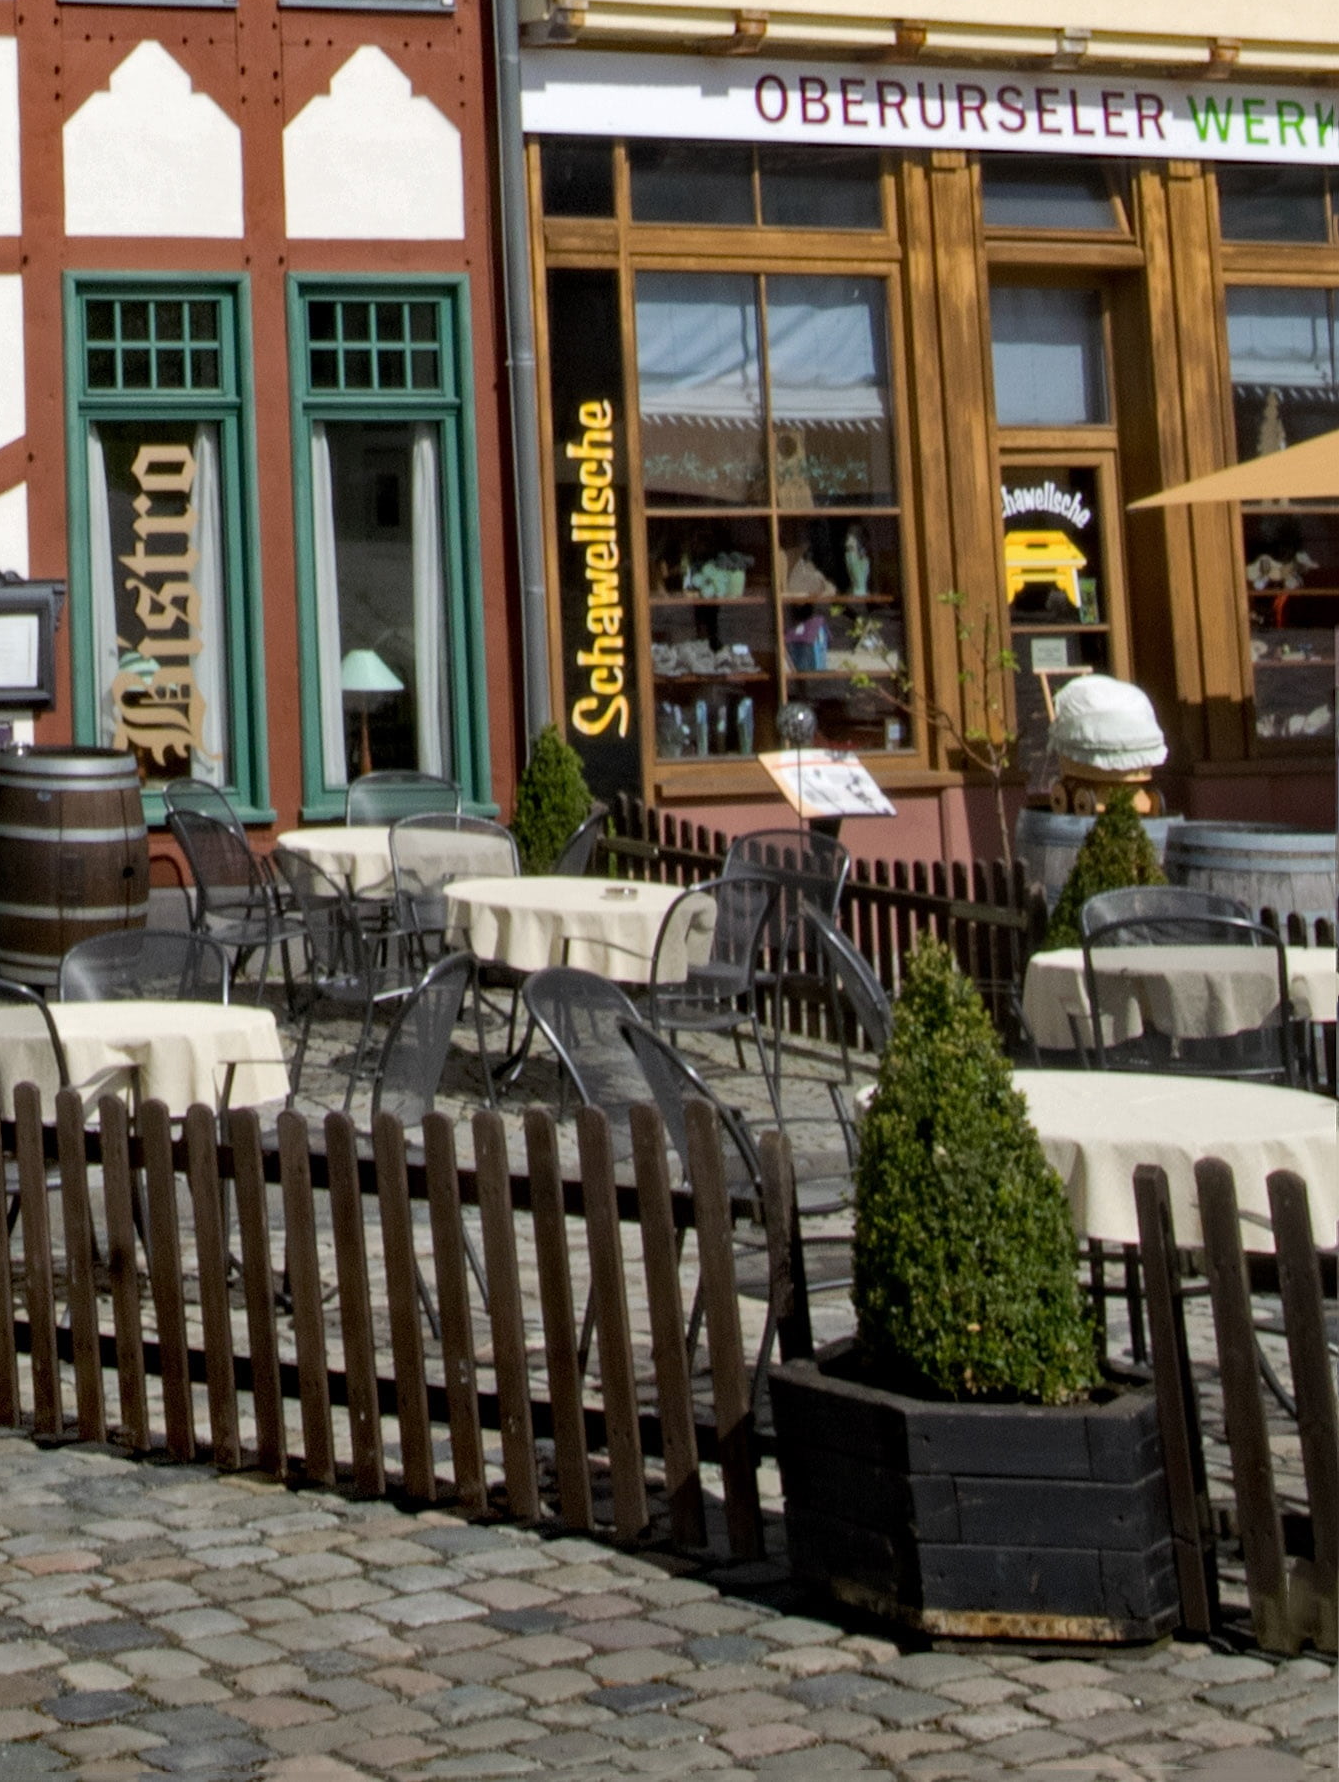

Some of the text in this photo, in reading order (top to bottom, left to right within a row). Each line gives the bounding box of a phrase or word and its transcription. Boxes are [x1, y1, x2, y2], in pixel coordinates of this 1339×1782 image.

[754, 73, 1167, 140] OBERURSELER
[566, 398, 629, 738] Schawellsche
[1001, 479, 1091, 529] hawellsche
[111, 444, 222, 767] Bistro
